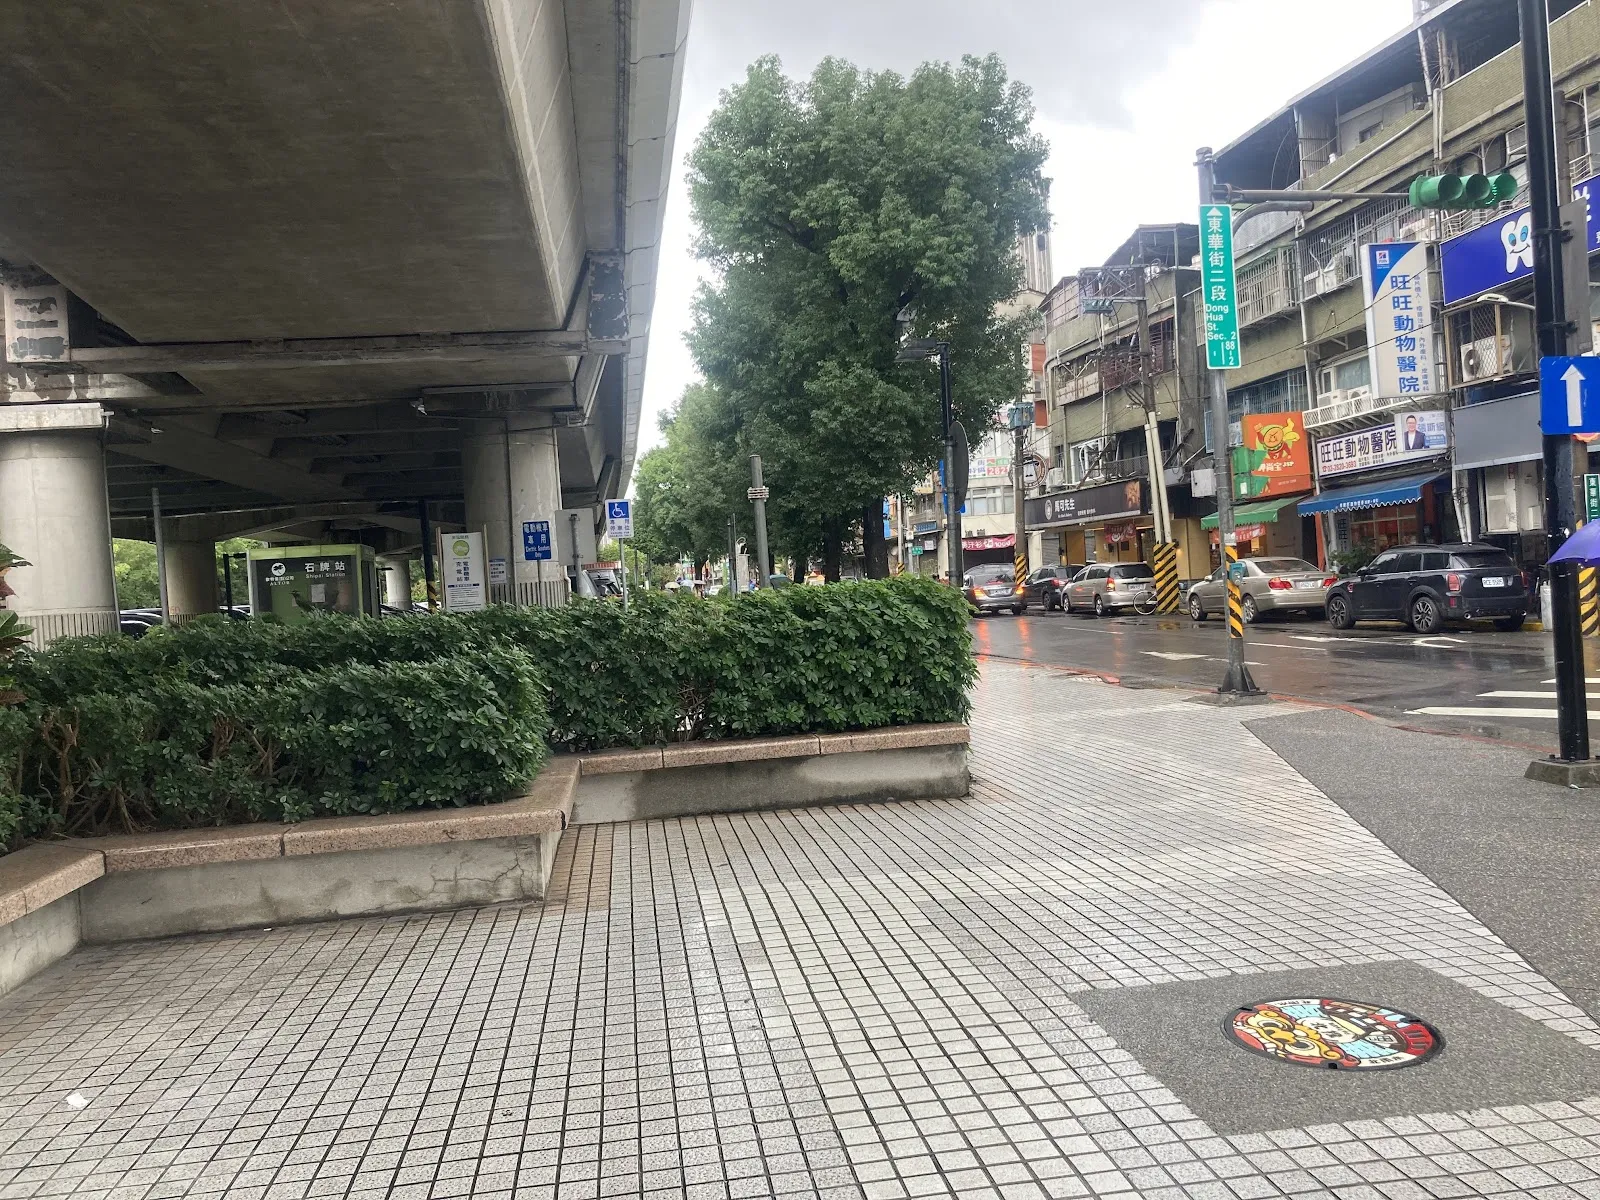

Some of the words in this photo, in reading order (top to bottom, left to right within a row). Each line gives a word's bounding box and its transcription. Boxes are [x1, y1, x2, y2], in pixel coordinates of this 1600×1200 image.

[1207, 217, 1226, 301] 東華街二段
[1206, 304, 1229, 313] Dong
[1206, 313, 1224, 321] Hua
[1207, 323, 1219, 331] St.
[1208, 332, 1227, 340] Sec.
[1231, 332, 1236, 340] 2
[1390, 274, 1420, 393] 旺旺動物醫院
[1225, 341, 1236, 350] 88
[1229, 357, 1234, 365] 2
[1320, 428, 1397, 463] 旺旺動物醫院
[1588, 477, 1599, 521] 東華街二
[528, 534, 546, 544] 專用
[305, 561, 345, 572] 石牌站
